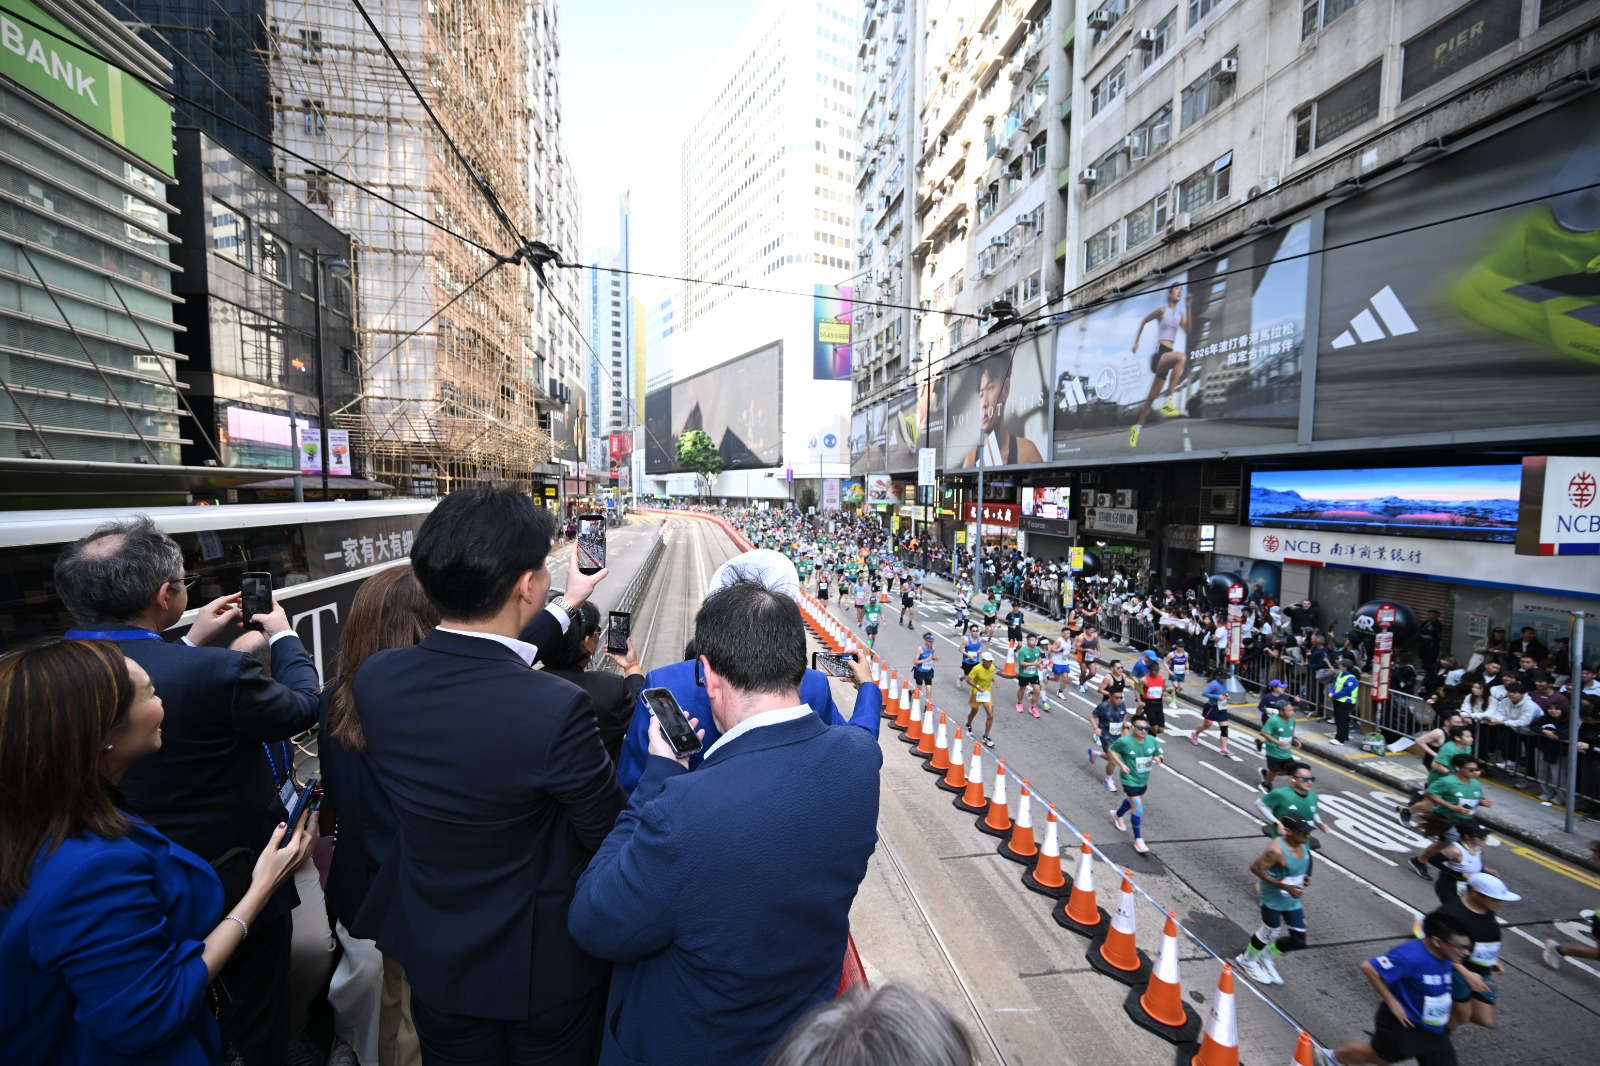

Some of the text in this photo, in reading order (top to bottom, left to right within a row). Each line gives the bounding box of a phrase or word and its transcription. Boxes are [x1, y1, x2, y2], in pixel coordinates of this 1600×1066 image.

[1432, 38, 1482, 72] BEAUTY
[1434, 20, 1484, 59] PIER
[1, 15, 98, 107] BANK
[1227, 338, 1293, 366] 指定合作夥伴
[952, 411, 971, 427] YOU
[979, 403, 1003, 420] GOT
[1010, 391, 1044, 413] THIS
[1557, 514, 1600, 533] NCB
[1284, 539, 1321, 554] NCB
[1330, 543, 1423, 564] 南洋商業銀行
